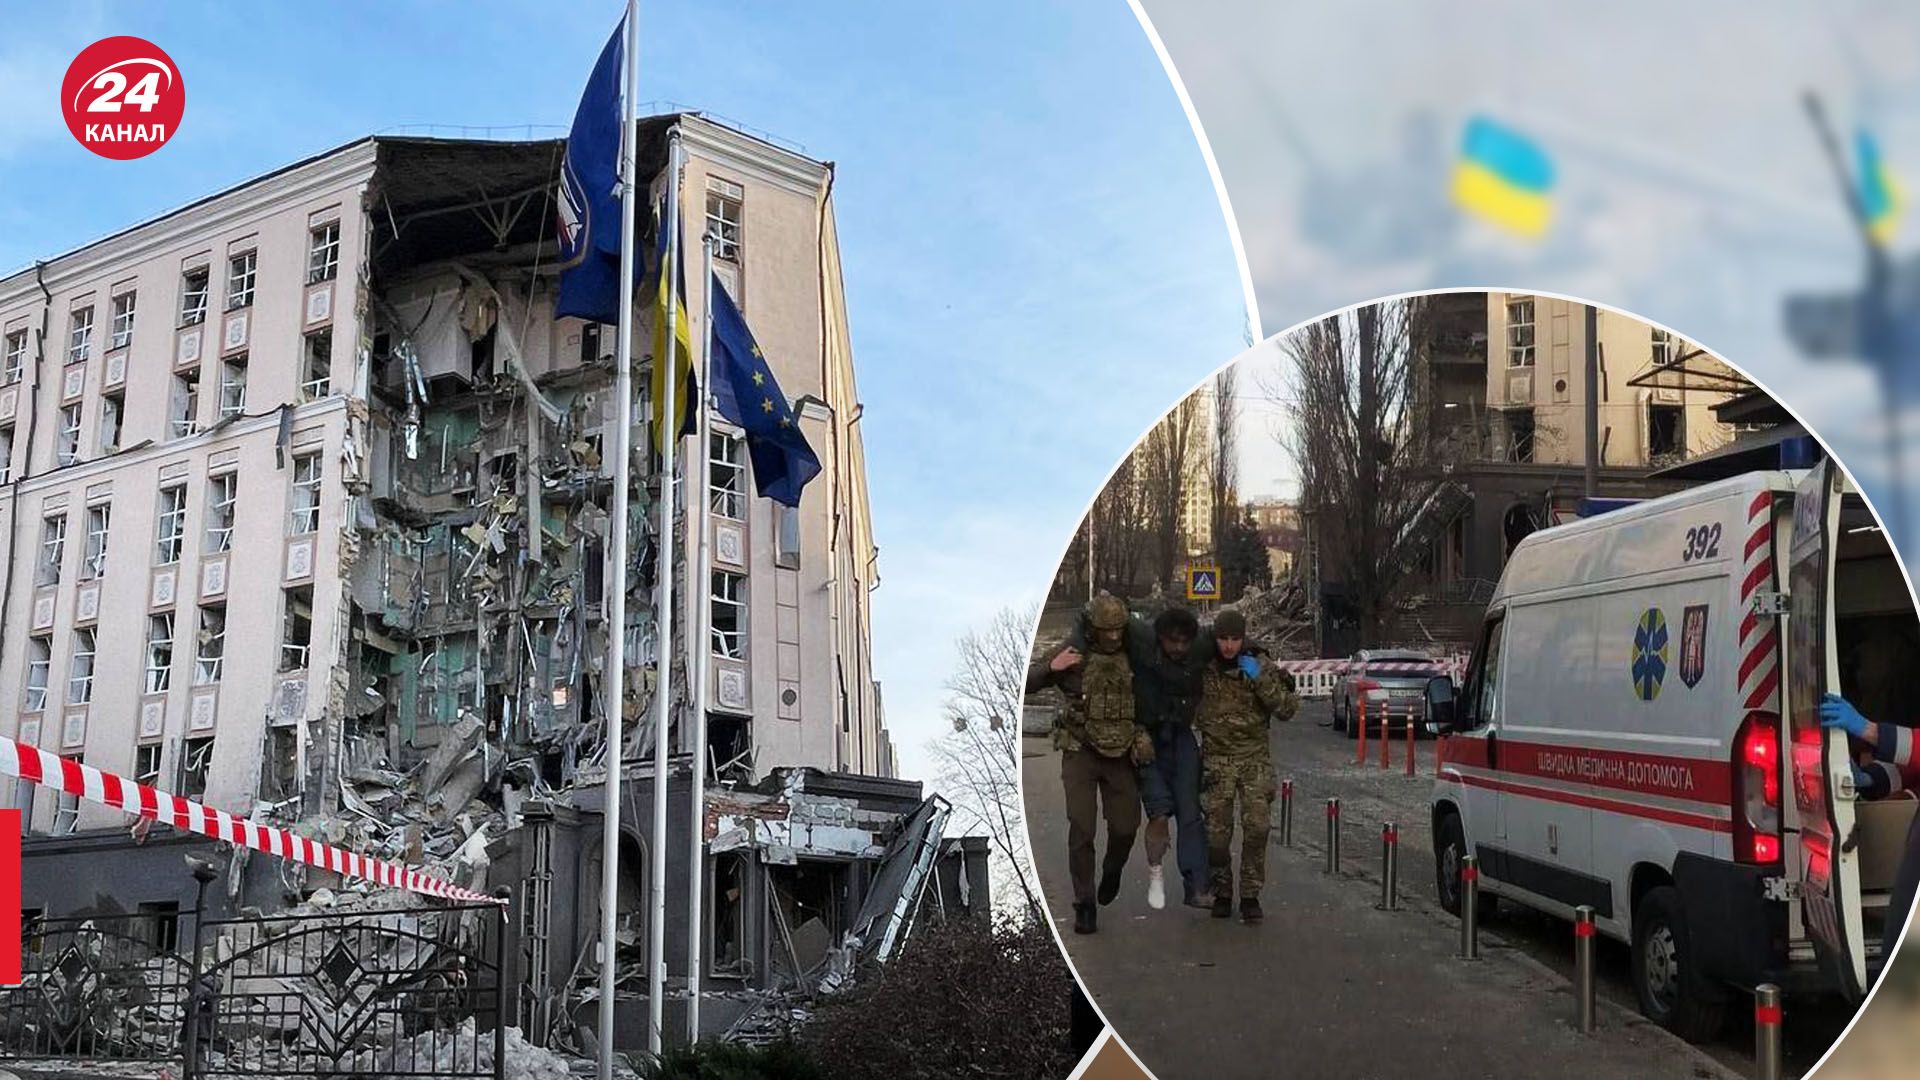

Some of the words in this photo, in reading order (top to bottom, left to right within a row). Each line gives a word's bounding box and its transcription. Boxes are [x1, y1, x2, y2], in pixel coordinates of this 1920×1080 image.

[1683, 522, 1722, 562] 392
[1537, 752, 1576, 776] ШВИДКА
[1576, 756, 1625, 781] МЕДИЧНА
[1626, 761, 1694, 791] ДОПОМОГА
